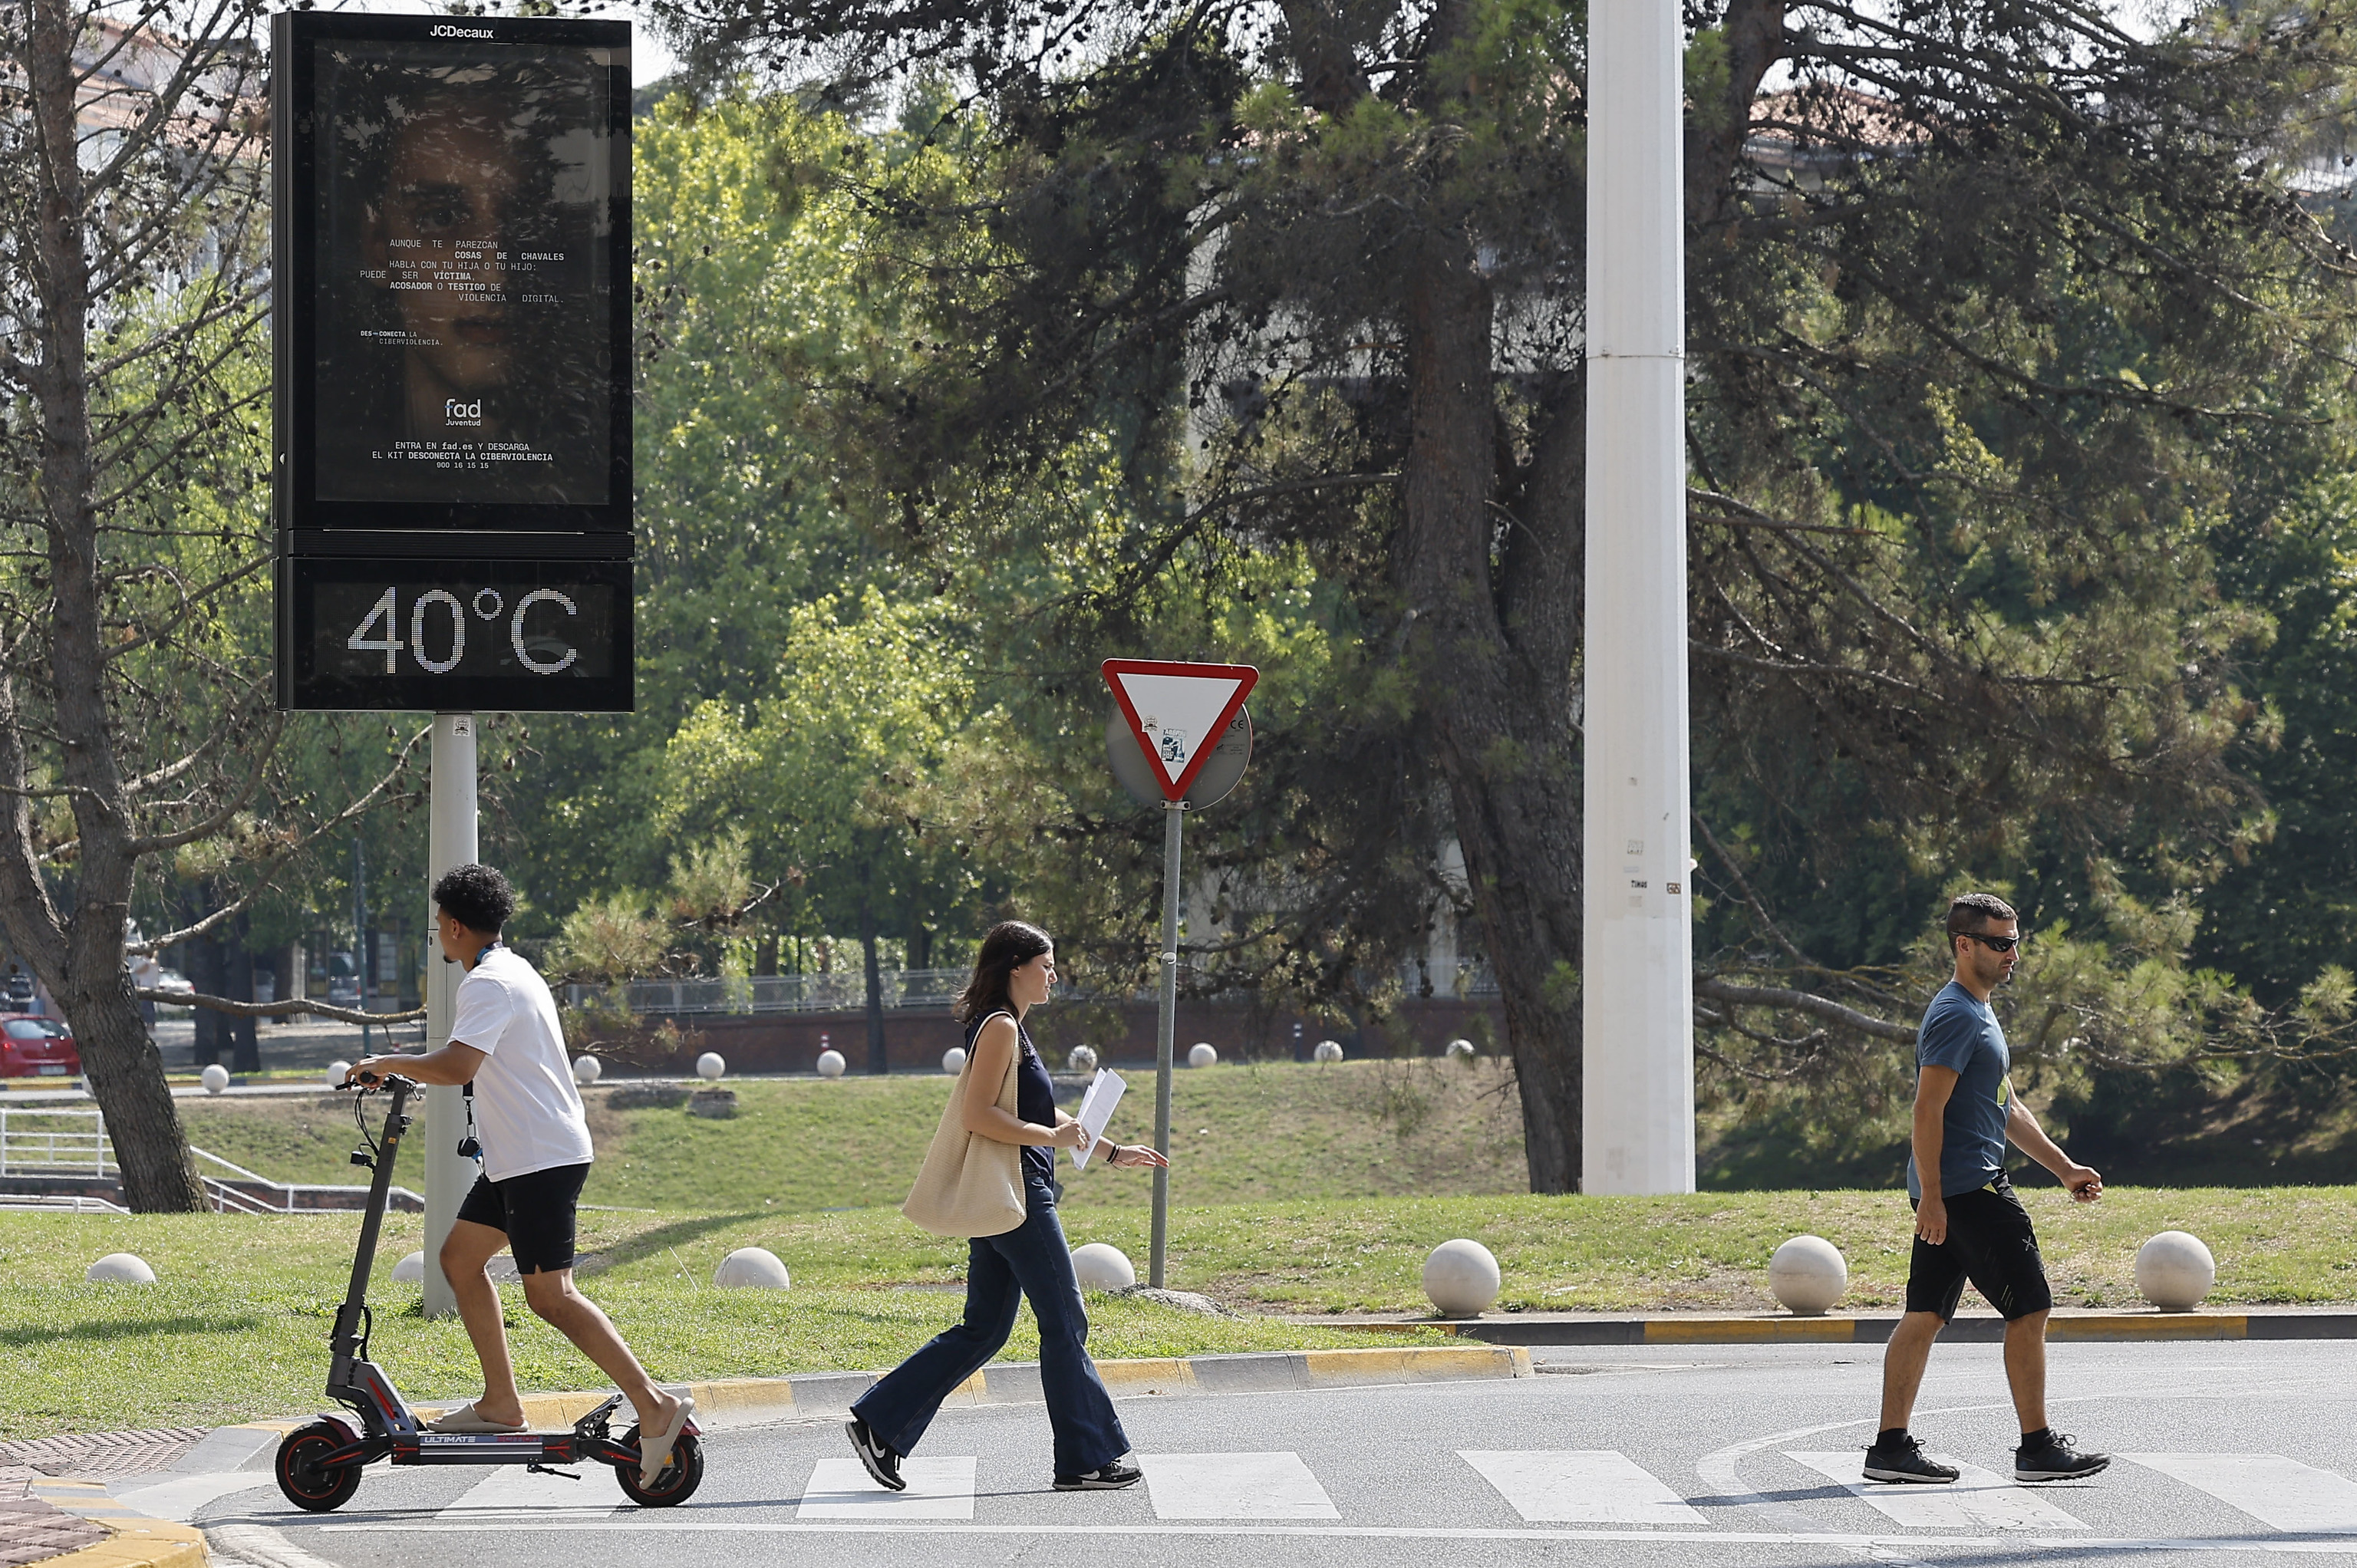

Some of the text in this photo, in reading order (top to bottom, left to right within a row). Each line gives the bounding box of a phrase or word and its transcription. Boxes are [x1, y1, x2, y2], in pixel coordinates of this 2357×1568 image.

[430, 25, 494, 39] JCDecaux
[390, 239, 498, 249] AUNQUE TE PAREZCAN
[454, 251, 565, 261] COSAS DE CHAVALES
[389, 260, 416, 268] HABLA
[420, 261, 437, 269] CON
[495, 262, 506, 271] TU
[360, 270, 475, 281] PUEDE SER VÍCTIMA,
[390, 282, 501, 292] ACOSADOR O TESTIGO DE
[458, 293, 564, 303] VIOLENCIA DIGITAL.
[444, 398, 481, 418] fad
[445, 418, 481, 427] Juventud
[395, 441, 422, 450] ENTRA
[442, 441, 473, 450] fad.es
[488, 443, 530, 451] DESCARGA
[387, 451, 404, 460] KIT
[408, 452, 461, 460] DESCONECTA
[480, 453, 553, 461] CIBERVIOLENCIA
[348, 586, 577, 675] 40°C
[1230, 720, 1244, 730] CE
